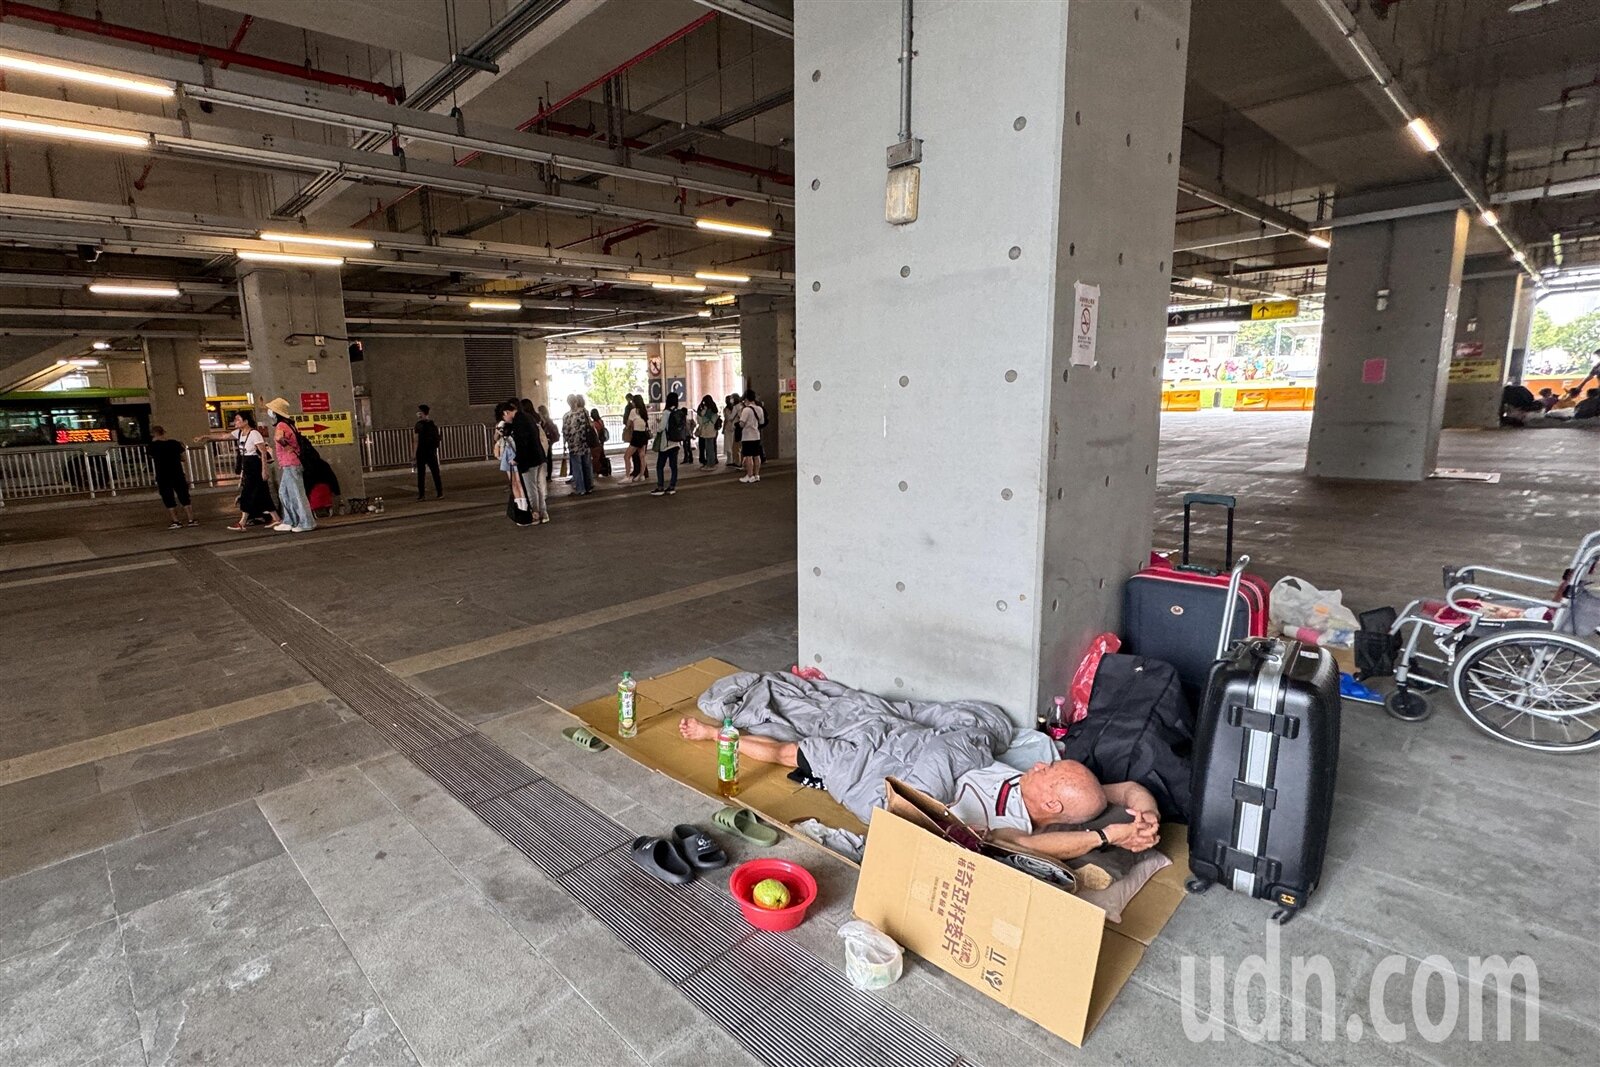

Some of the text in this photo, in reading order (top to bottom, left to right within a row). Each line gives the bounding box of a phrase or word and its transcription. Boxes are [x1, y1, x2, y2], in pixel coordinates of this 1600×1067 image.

[651, 381, 661, 400] C
[941, 869, 975, 956] 奇亞籽麥片
